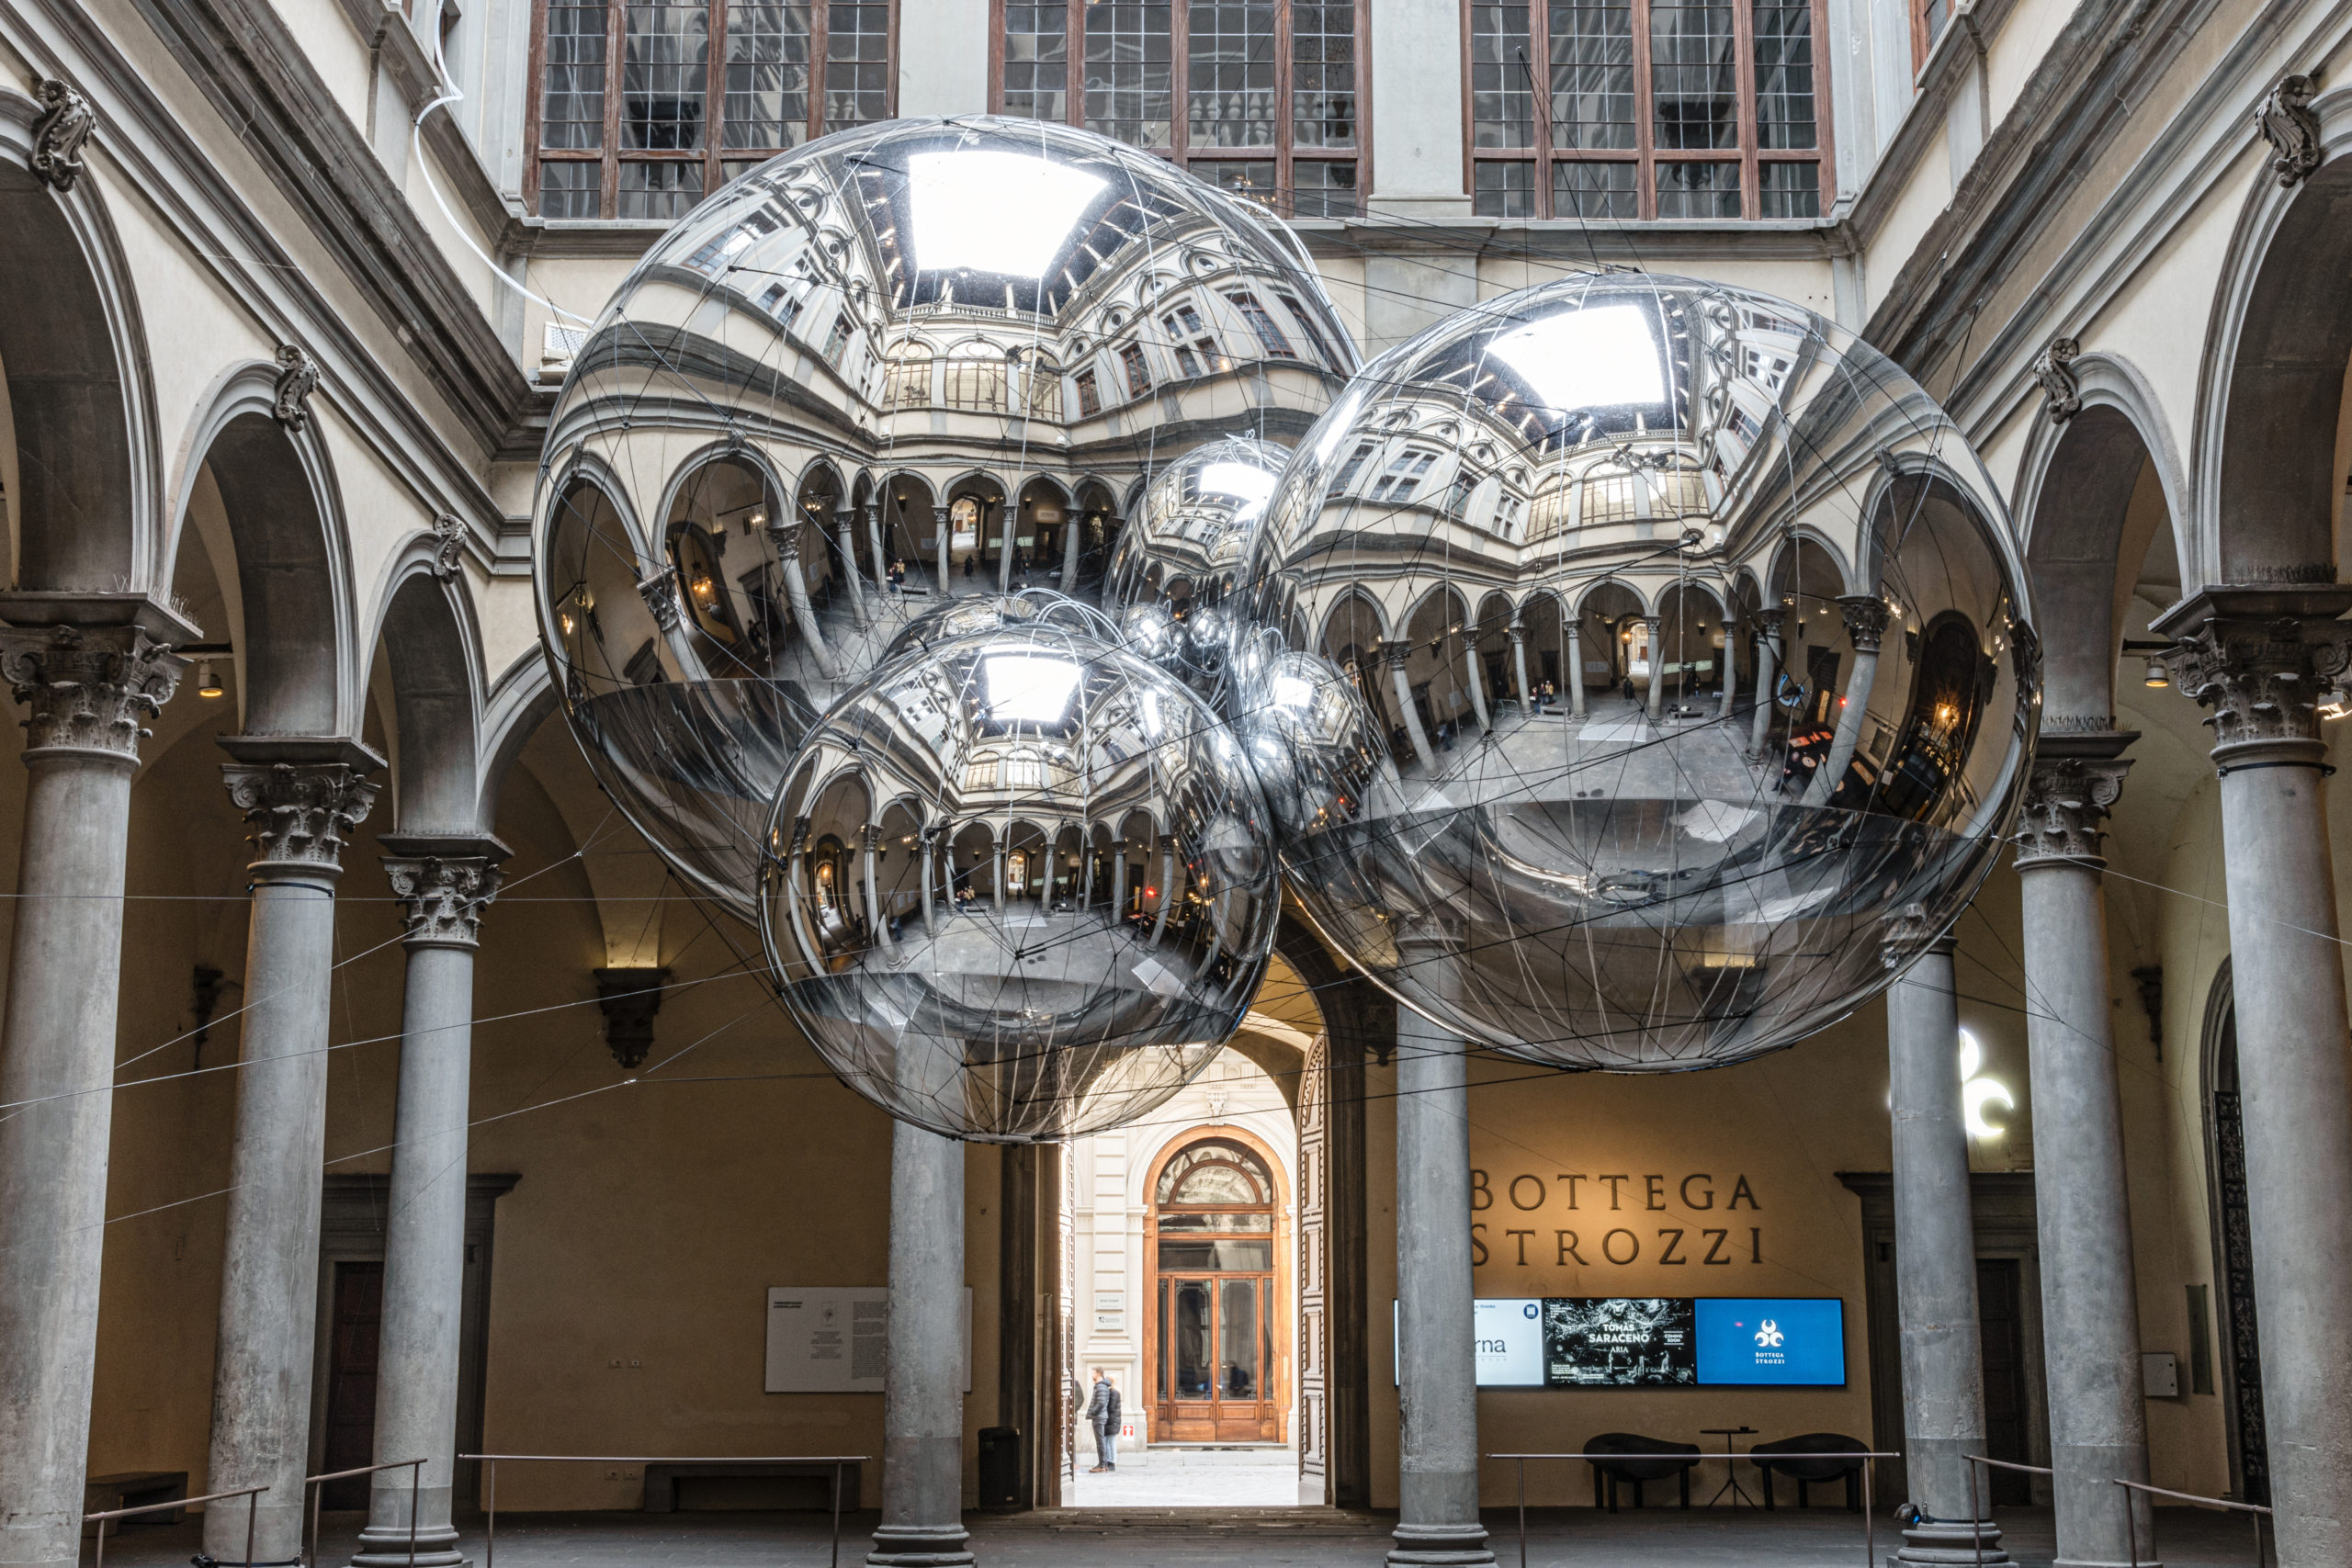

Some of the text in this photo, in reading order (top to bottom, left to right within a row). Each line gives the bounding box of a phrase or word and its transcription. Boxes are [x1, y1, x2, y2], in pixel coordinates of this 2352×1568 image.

[1470, 1168, 1762, 1212] BOTTEGA
[1471, 1223, 1763, 1267] STROZZI
[1589, 1333, 1650, 1343] SARACENO
[1611, 1346, 1629, 1354] ARIA
